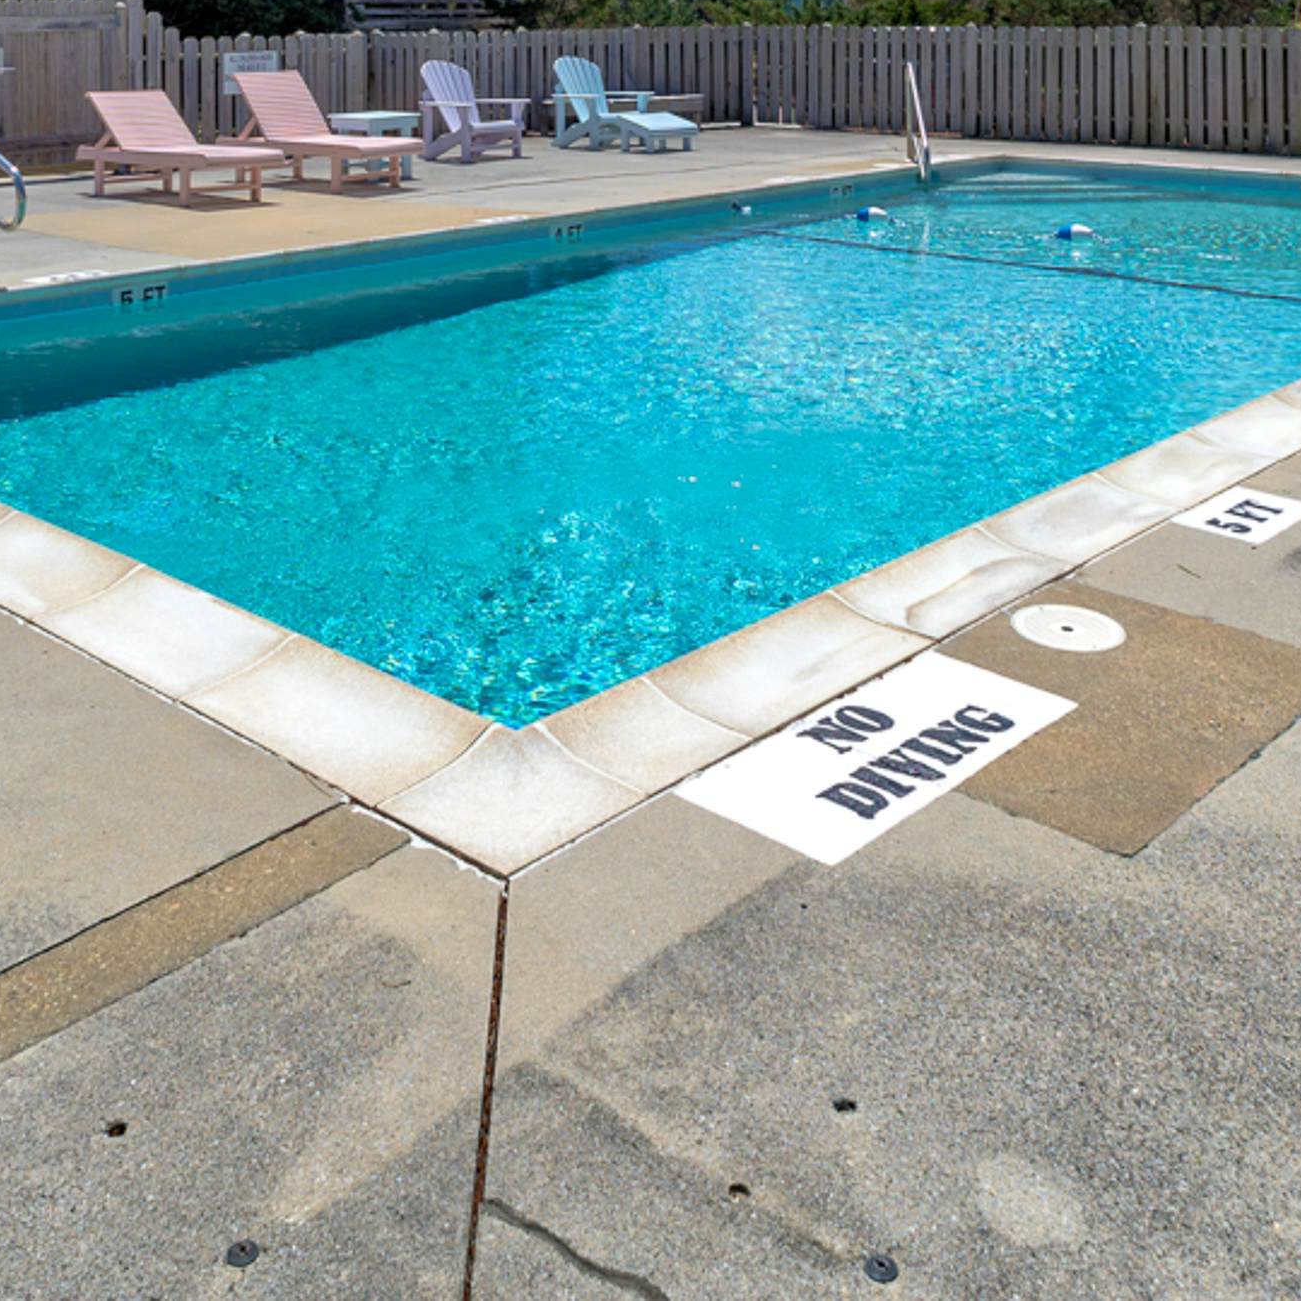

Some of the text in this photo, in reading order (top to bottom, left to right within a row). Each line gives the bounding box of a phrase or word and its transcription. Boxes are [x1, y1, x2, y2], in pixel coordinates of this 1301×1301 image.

[142, 285, 166, 302] FT
[1205, 499, 1283, 534] 5 FT
[796, 705, 895, 755] NO
[815, 704, 1015, 819] DIVING
